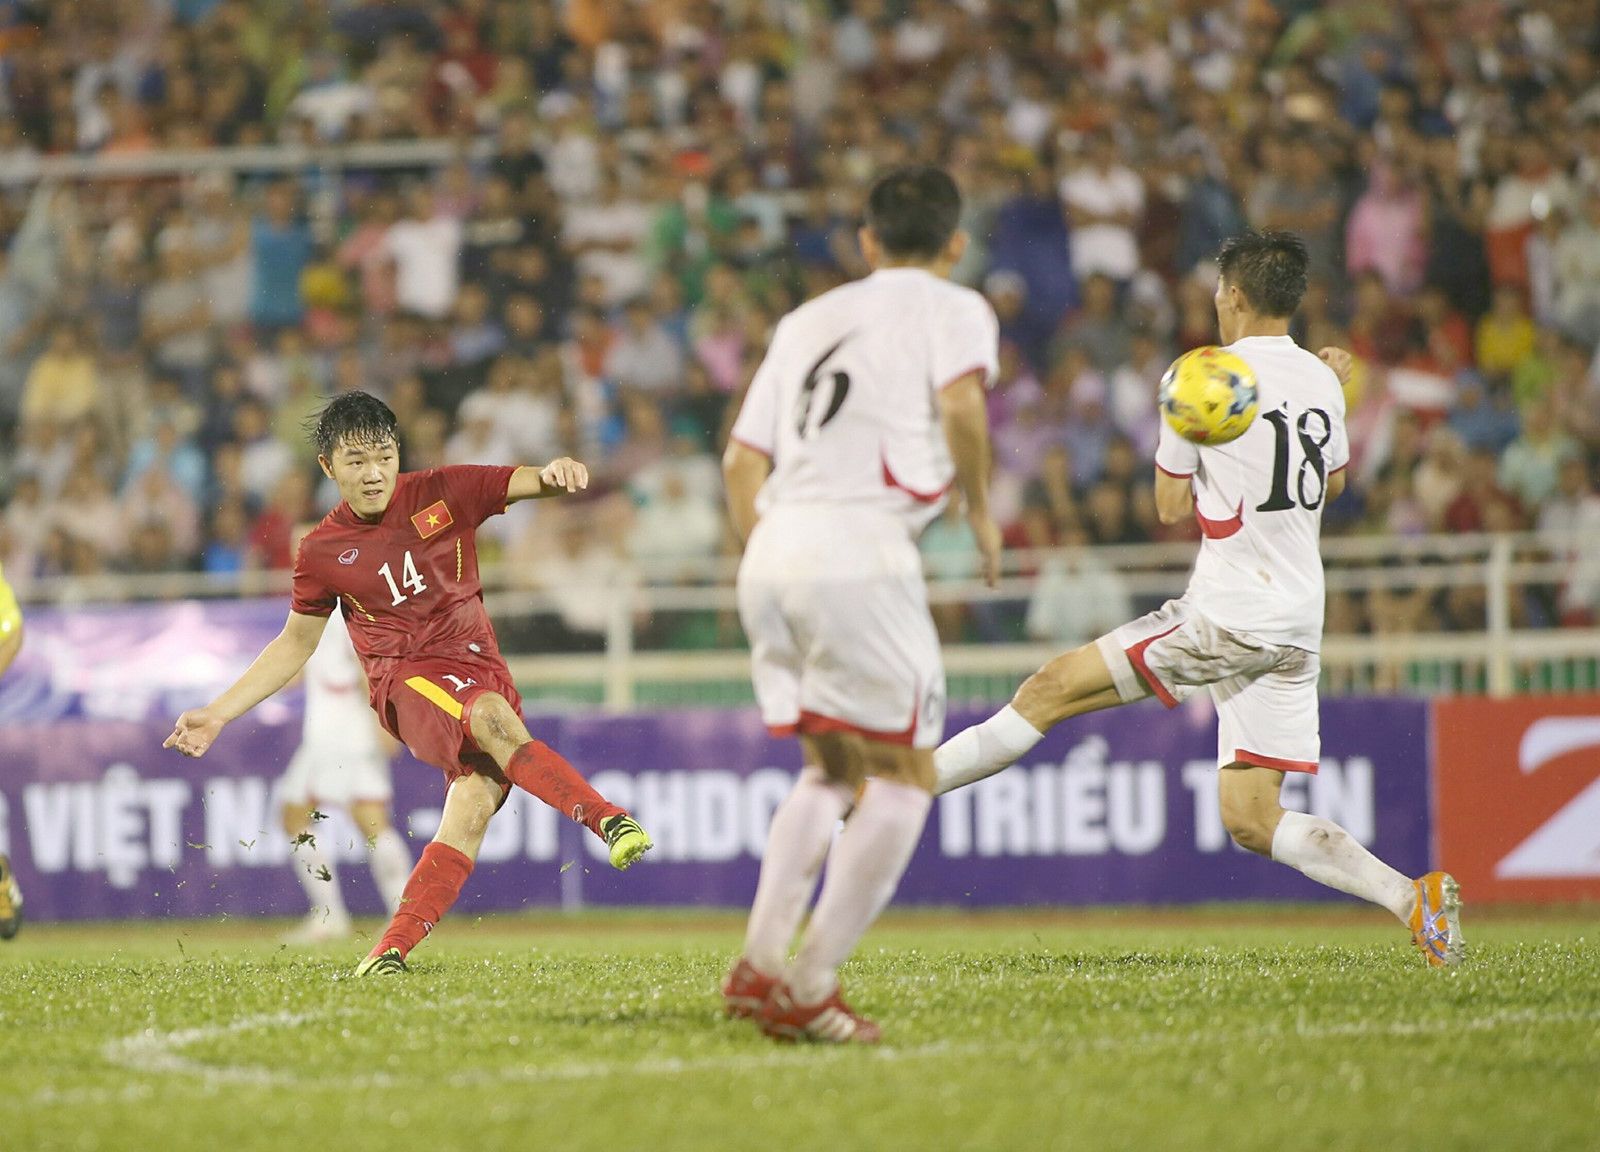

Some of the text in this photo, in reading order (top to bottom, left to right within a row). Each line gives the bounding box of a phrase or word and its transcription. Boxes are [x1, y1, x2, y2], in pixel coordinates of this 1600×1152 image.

[798, 328, 857, 438] 6
[1256, 401, 1331, 511] 18
[378, 550, 427, 607] 14
